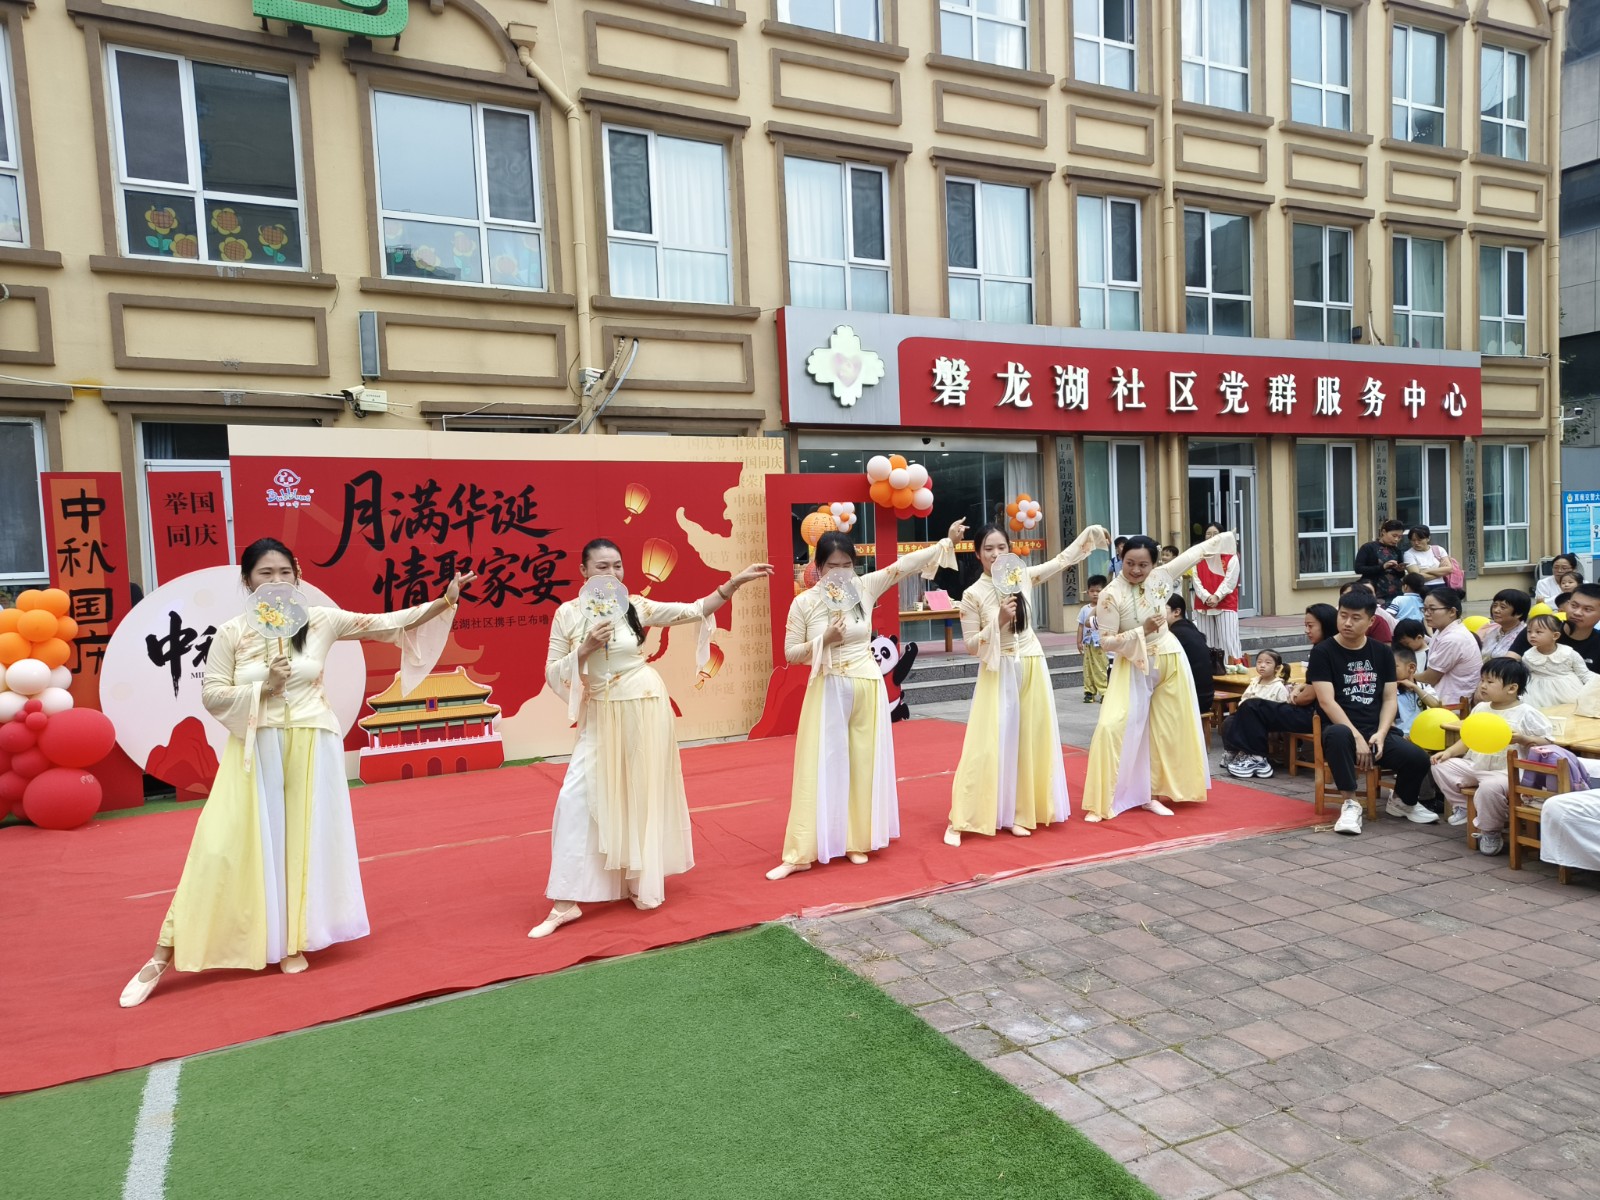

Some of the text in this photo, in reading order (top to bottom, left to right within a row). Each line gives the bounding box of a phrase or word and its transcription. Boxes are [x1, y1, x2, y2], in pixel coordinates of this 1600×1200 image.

[932, 356, 1468, 419] 磐龙湖社区党群服务中心
[732, 437, 783, 451] 中秋国庆
[164, 491, 216, 516] 举国
[310, 470, 564, 567] 月满华诞
[167, 524, 219, 547] 同庆
[736, 530, 766, 545] 繁荣
[1061, 480, 1077, 598] 磐龙湖社区委员会
[57, 487, 117, 675] 中秋国庆
[373, 544, 581, 612] 情聚家宴
[451, 614, 553, 631] 龙湖社区携手巴布噜
[1347, 659, 1373, 671] TEA
